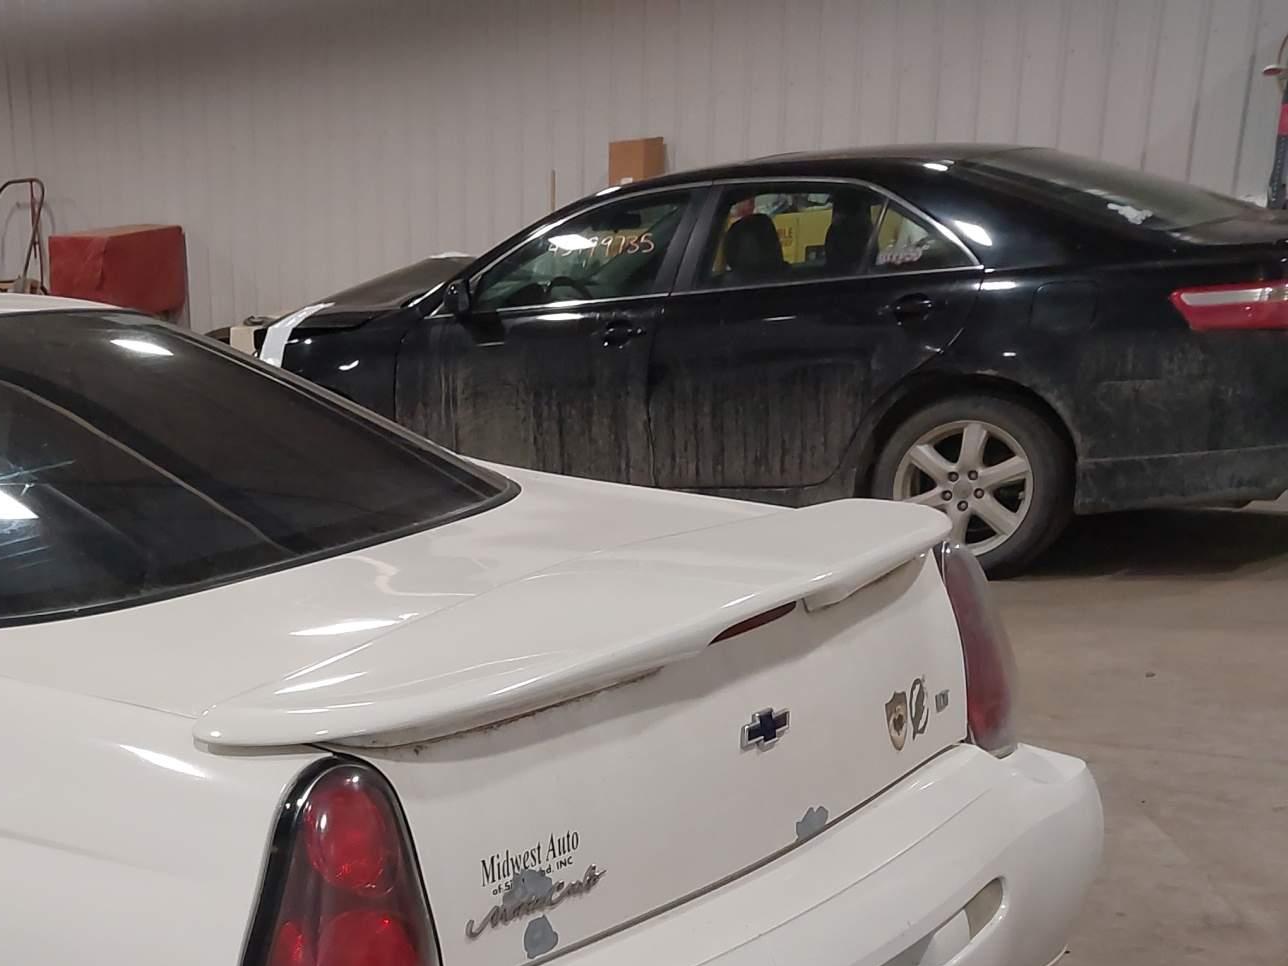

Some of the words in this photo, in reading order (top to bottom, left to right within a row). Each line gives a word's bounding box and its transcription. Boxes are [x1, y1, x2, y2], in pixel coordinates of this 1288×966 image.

[548, 232, 655, 257] 499735
[480, 841, 542, 887] Midwest
[546, 830, 579, 861] Auto
[492, 884, 503, 895] of
[556, 855, 573, 869] INC
